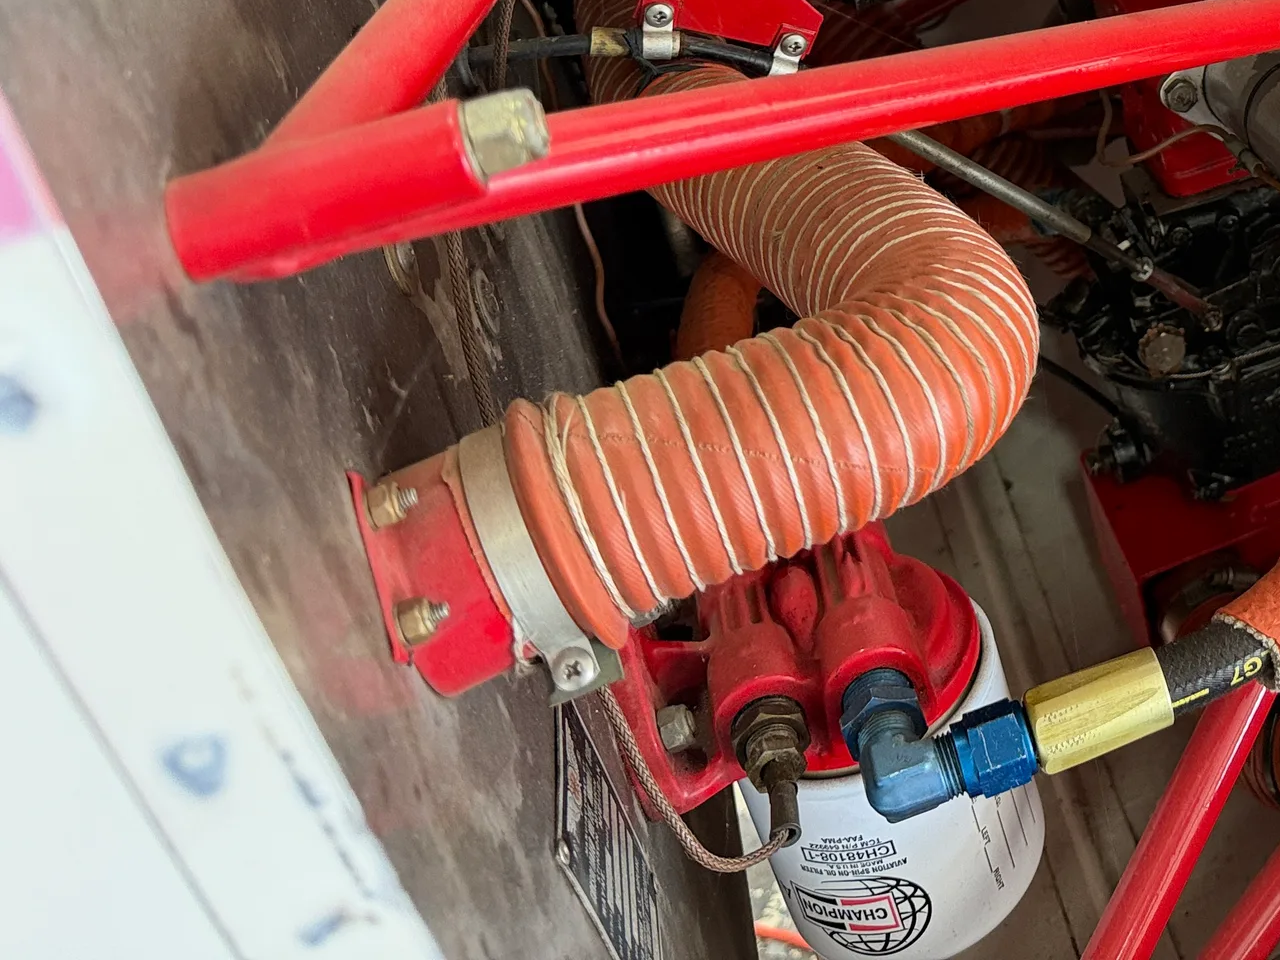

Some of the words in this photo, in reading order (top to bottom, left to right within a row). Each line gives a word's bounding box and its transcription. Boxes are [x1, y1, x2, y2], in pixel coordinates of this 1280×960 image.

[820, 834, 864, 843] FAA-PMA
[860, 837, 882, 847] TCM
[808, 845, 890, 861] CH48108-1
[981, 826, 991, 845] LEFT
[993, 866, 1005, 890] RIGHT
[800, 863, 824, 875] FILTER
[861, 859, 884, 868] MADE
[872, 857, 907, 873] AVIATION
[839, 868, 871, 876] SPIN-ON
[803, 898, 888, 921] CHAMPION
